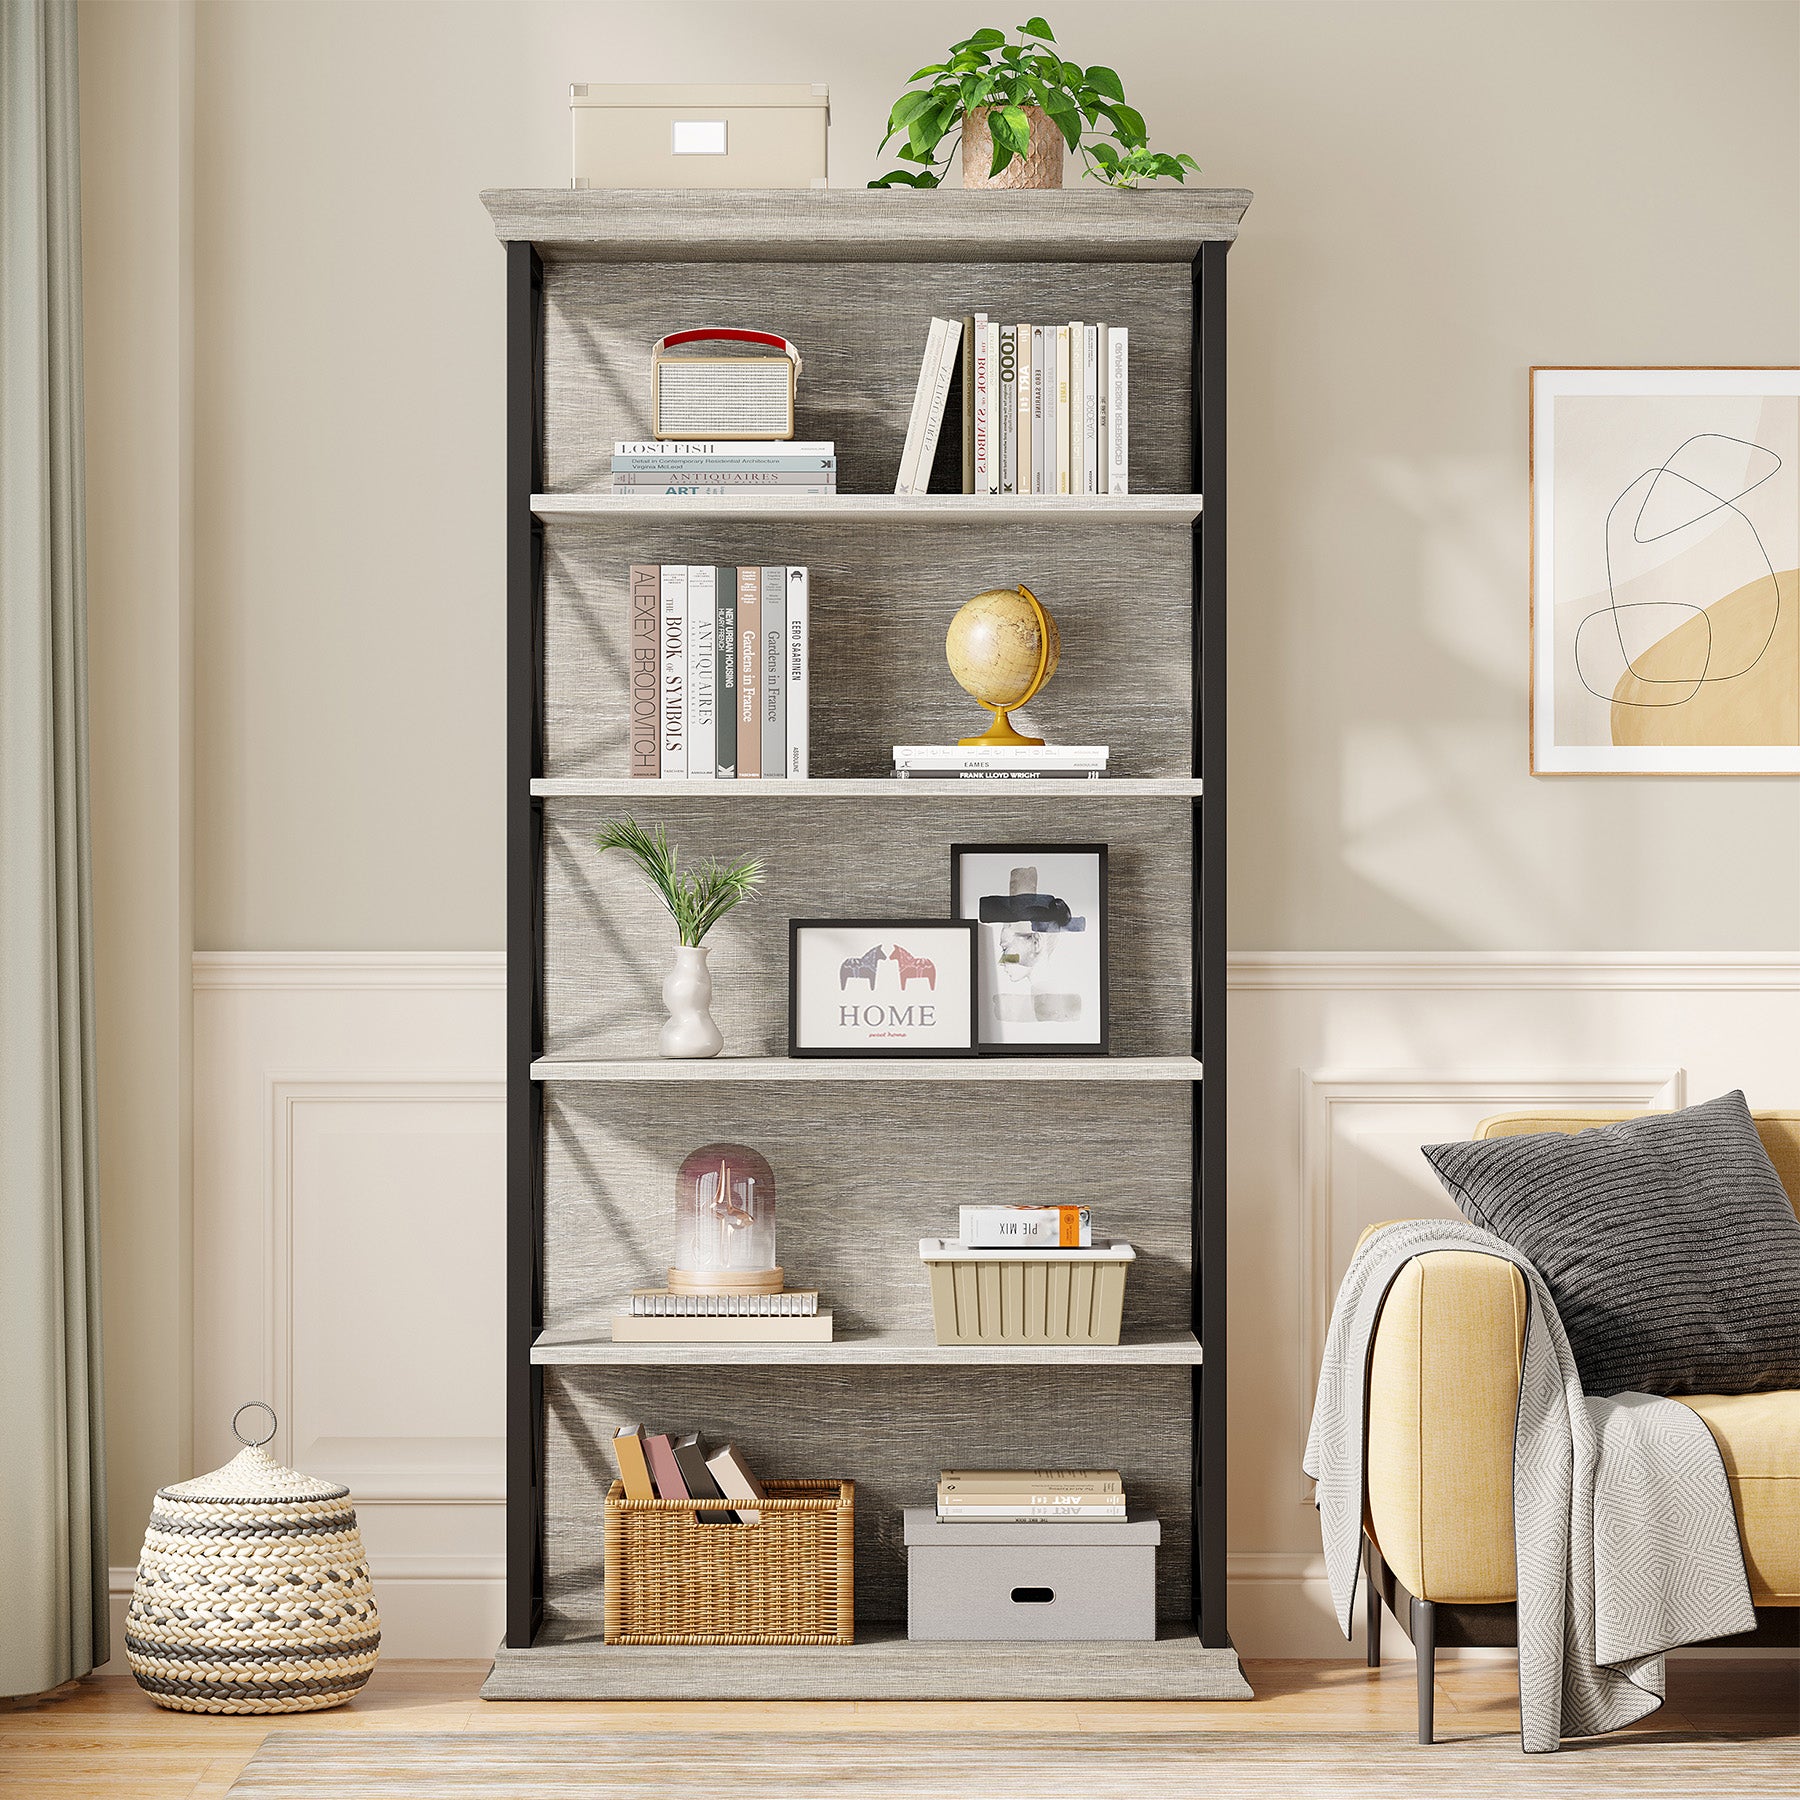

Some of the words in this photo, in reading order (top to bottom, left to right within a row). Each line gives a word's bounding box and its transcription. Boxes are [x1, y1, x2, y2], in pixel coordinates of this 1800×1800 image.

[622, 445, 669, 454] LOST
[674, 445, 714, 454] FISH
[670, 473, 778, 481] ANTIQUAIRES
[665, 486, 700, 495] ART
[634, 570, 656, 642] ALEXEY
[666, 598, 674, 614] THE
[725, 608, 734, 626] NEW
[666, 616, 683, 660] BOOK
[725, 626, 734, 653] URBAN
[792, 620, 802, 640] EERO
[743, 630, 756, 673] Gardens
[768, 631, 781, 673] Gardens
[792, 642, 802, 681] SAARINEN
[666, 662, 674, 672] OF
[696, 620, 713, 726] ANTIQUAIRES
[725, 653, 734, 688] HOUSING
[743, 674, 756, 686] in
[768, 674, 780, 685] in
[634, 648, 656, 767] BRODOVITCH
[665, 676, 683, 752] SYMBOLS
[743, 687, 756, 723] France
[768, 688, 780, 722] France
[839, 1005, 937, 1027] HOME
[999, 1223, 1017, 1235] MIX
[1022, 1223, 1038, 1235] PIE
[1052, 1496, 1082, 1504] ART
[1052, 1507, 1082, 1515] ART
